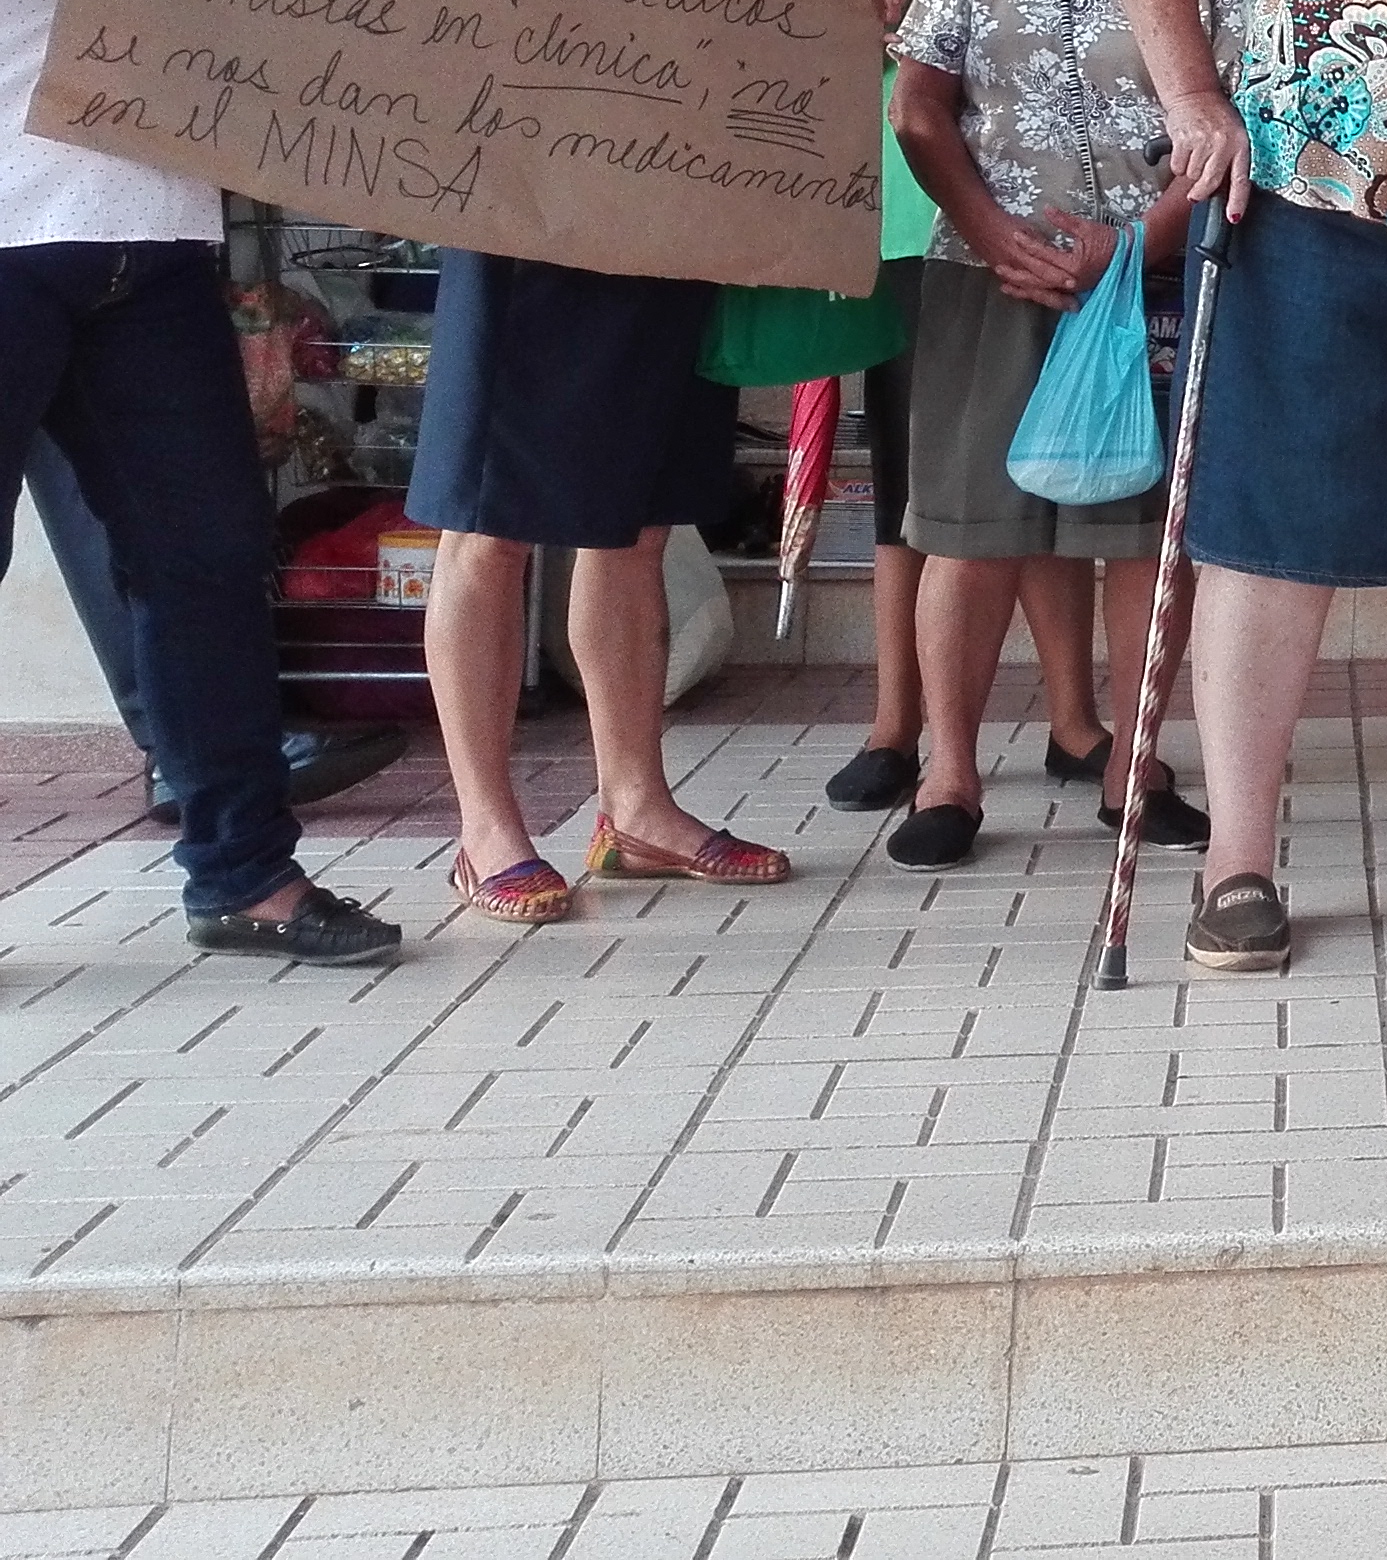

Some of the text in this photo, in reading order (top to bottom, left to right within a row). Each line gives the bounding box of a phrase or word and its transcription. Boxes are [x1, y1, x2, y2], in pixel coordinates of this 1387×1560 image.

[422, 5, 496, 50] en
[76, 24, 143, 67] se
[161, 48, 280, 96] nos
[299, 49, 429, 125] dan
[454, 72, 542, 139] los
[66, 90, 159, 130] en
[173, 84, 234, 150] el
